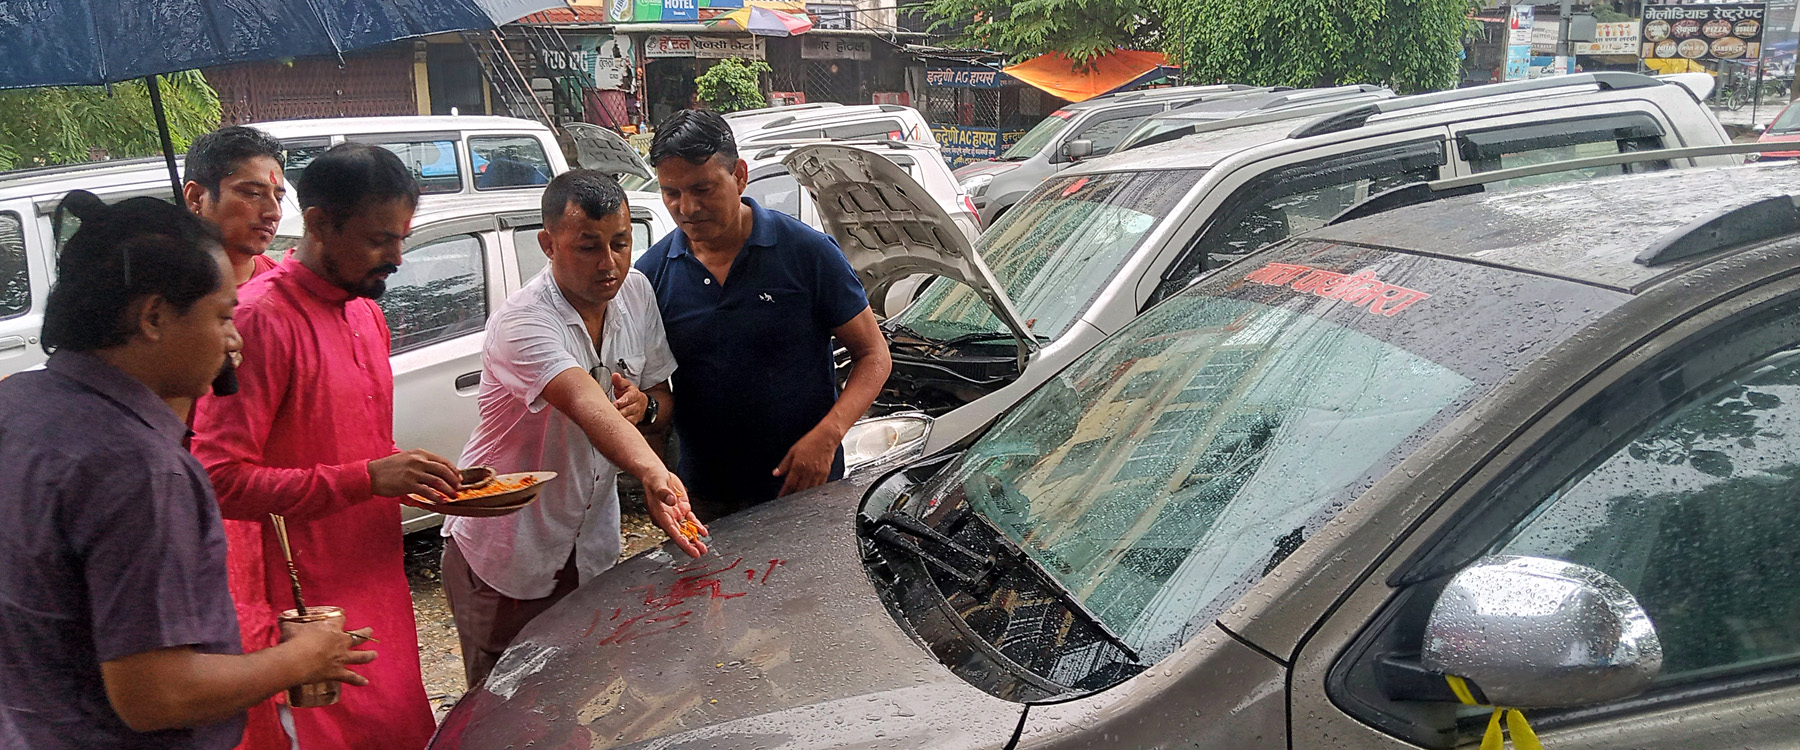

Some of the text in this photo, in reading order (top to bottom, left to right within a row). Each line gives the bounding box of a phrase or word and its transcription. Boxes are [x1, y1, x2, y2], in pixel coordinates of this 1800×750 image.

[664, 0, 694, 9] HOTEL
[955, 72, 968, 83] AC
[931, 126, 997, 148] न्द्रेणी AC हायस
